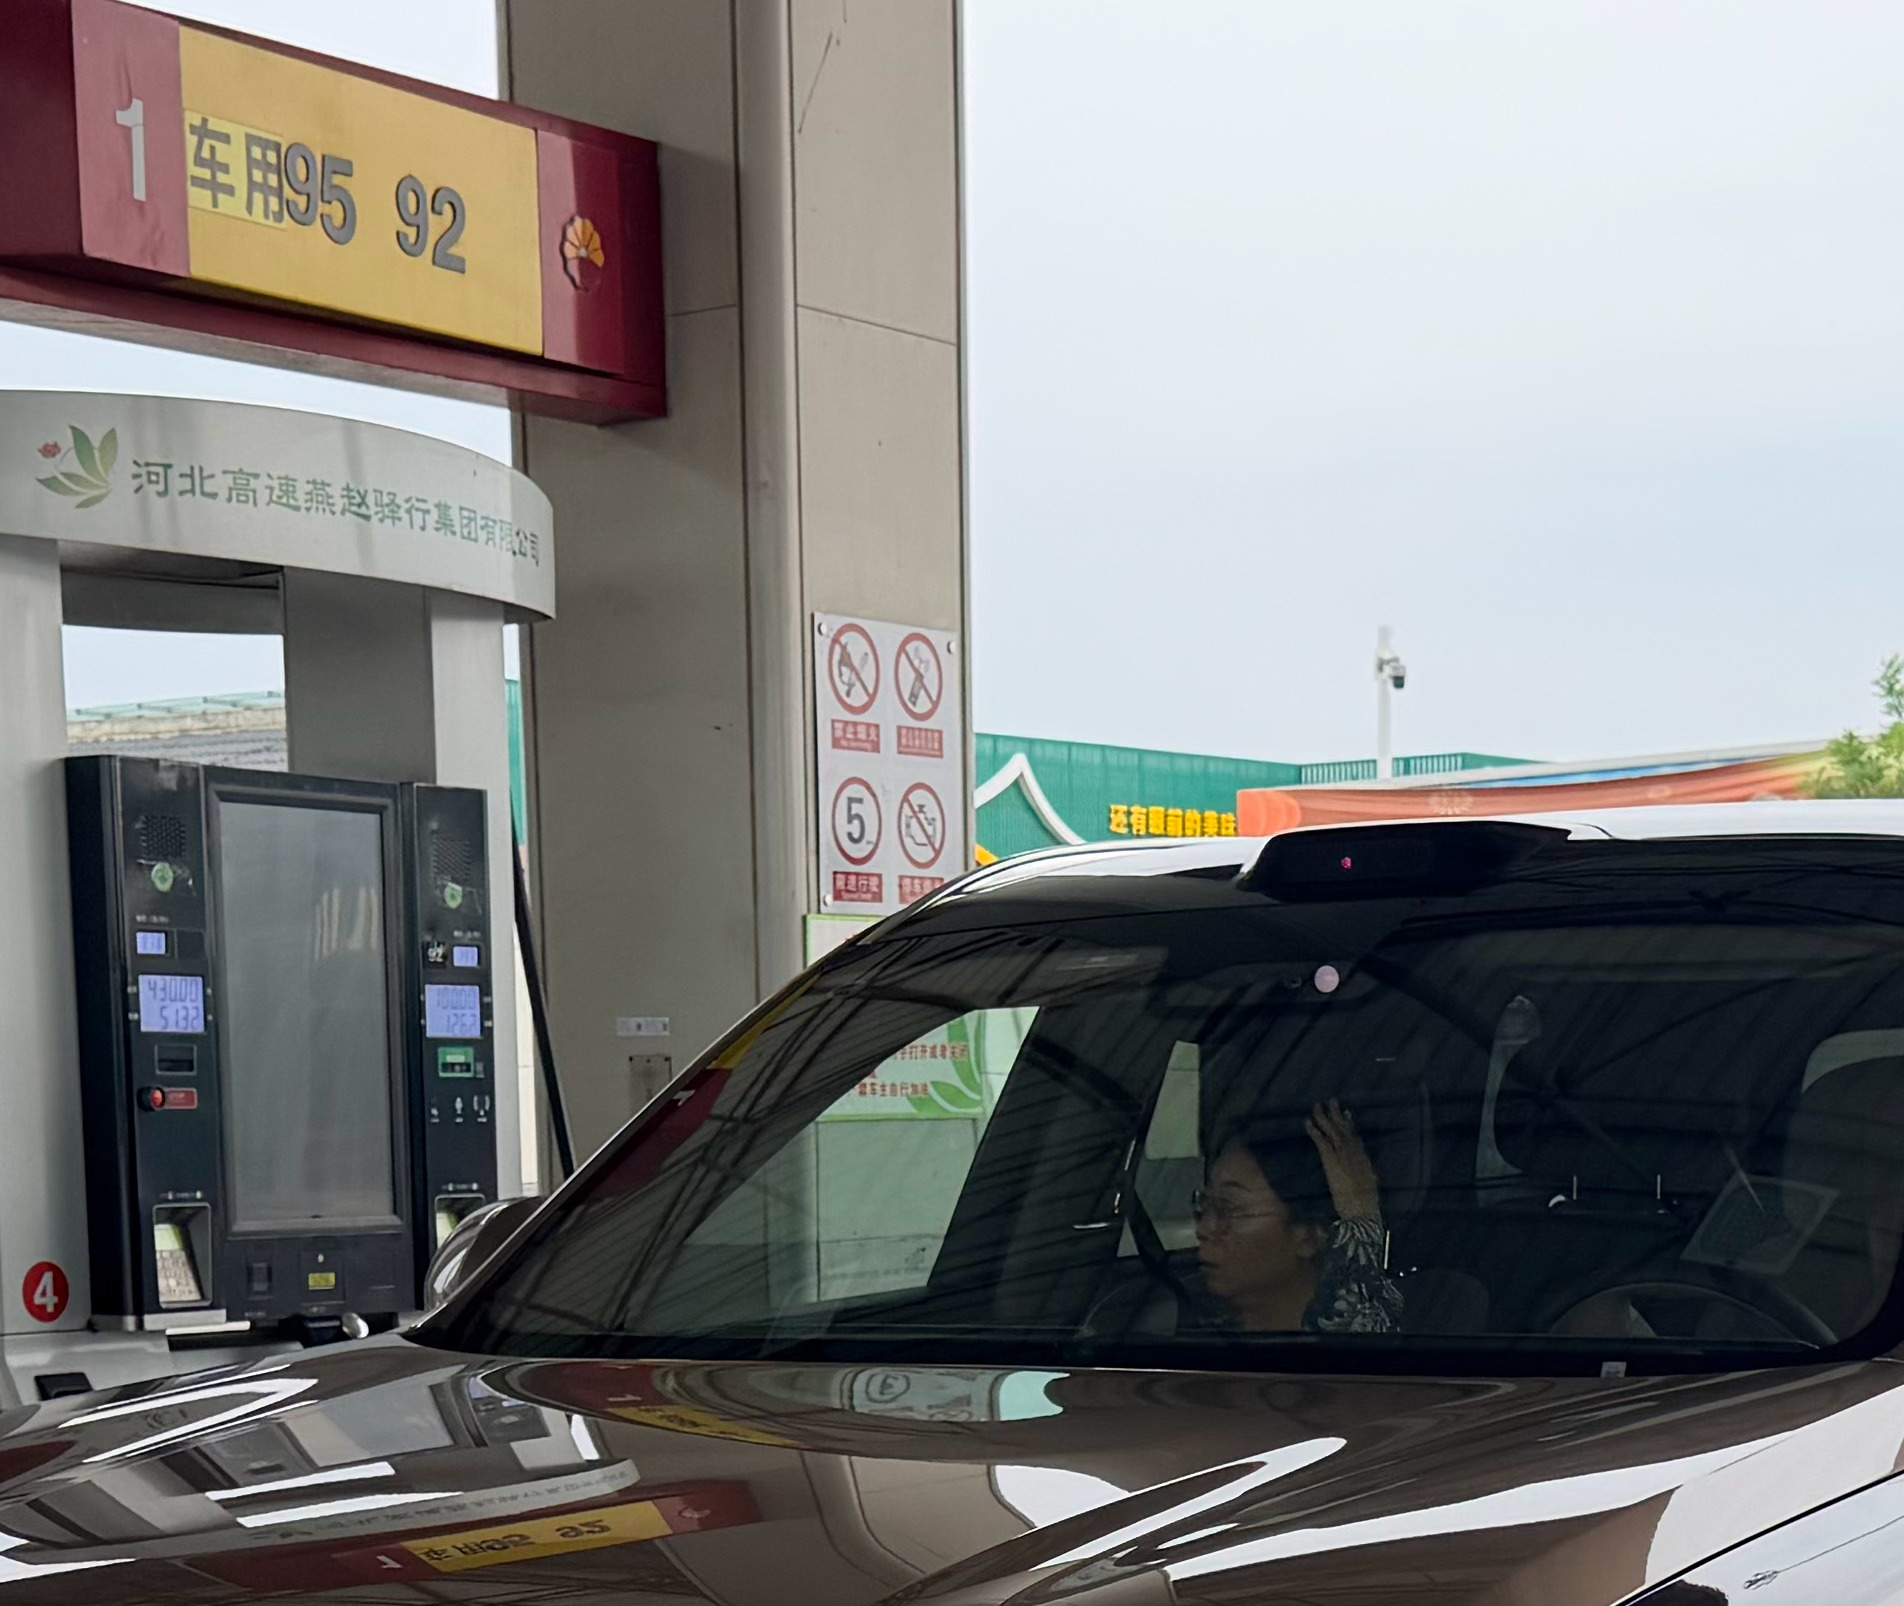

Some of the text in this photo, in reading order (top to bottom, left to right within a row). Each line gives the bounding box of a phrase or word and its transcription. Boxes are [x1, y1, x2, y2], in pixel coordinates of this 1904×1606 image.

[115, 98, 146, 202] 1
[395, 174, 467, 275] 92
[131, 458, 542, 567] 河北高速燕赵驿行集团有限公司
[847, 797, 865, 844] 5
[33, 1271, 59, 1313] 4
